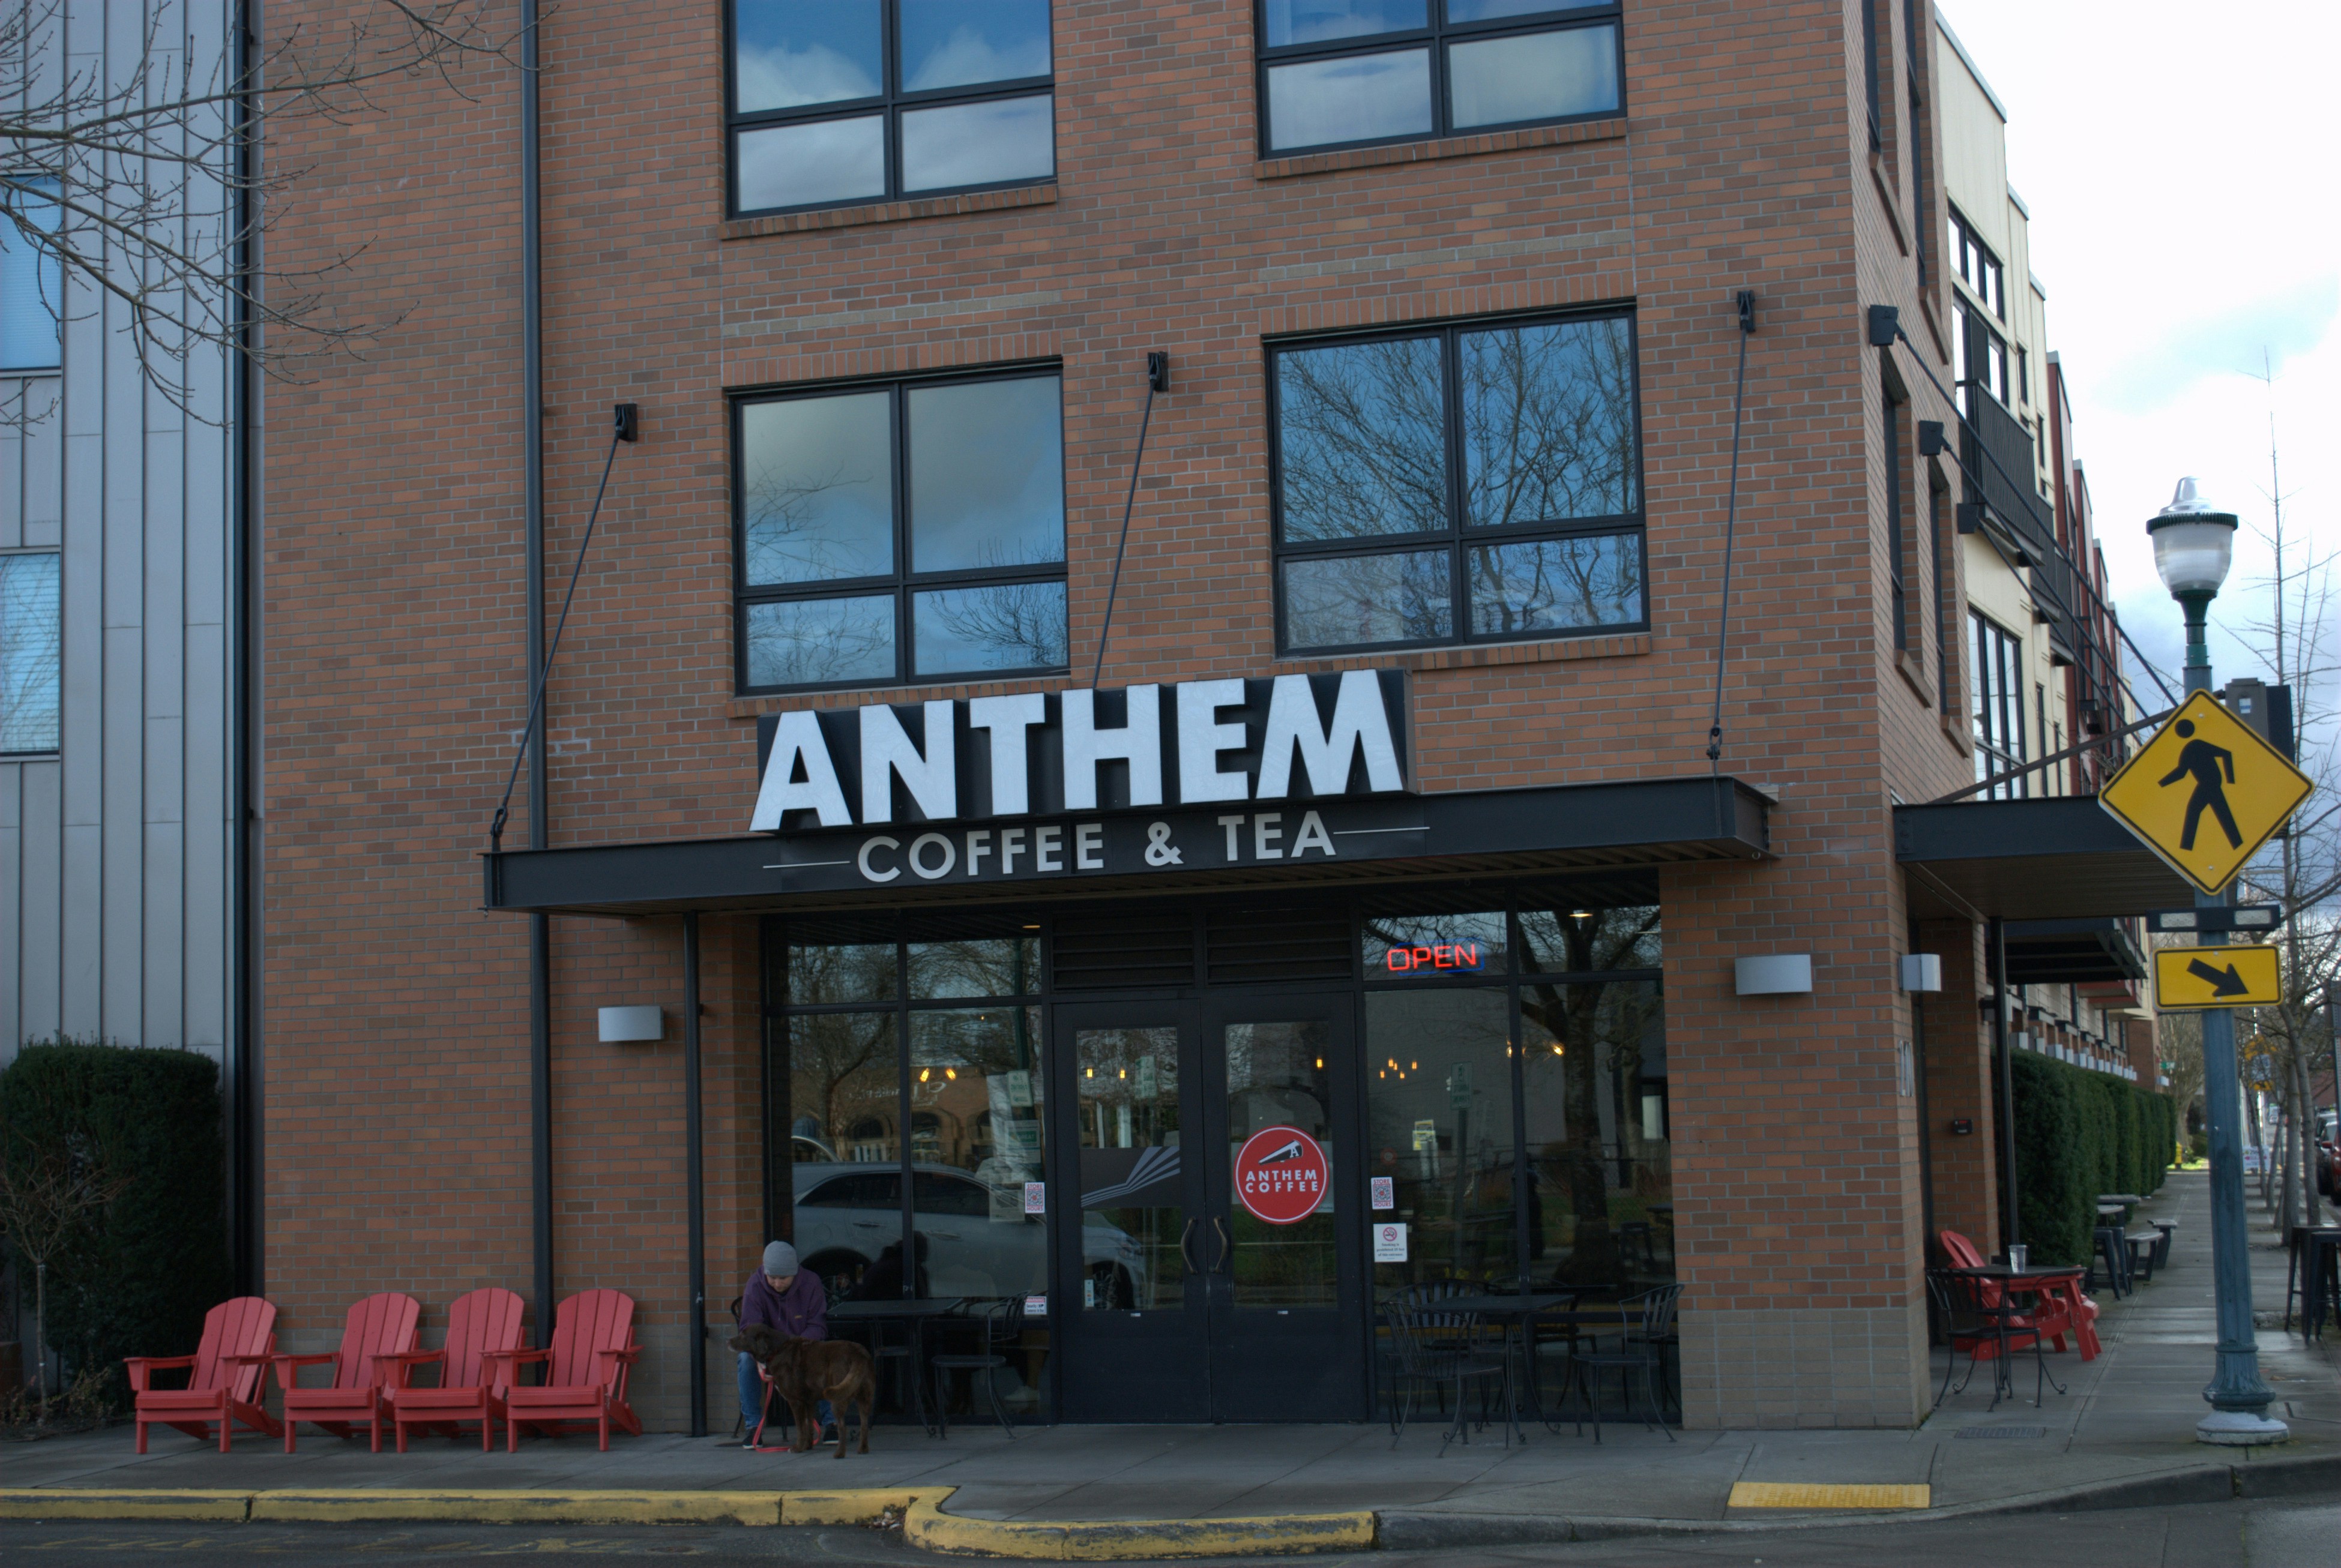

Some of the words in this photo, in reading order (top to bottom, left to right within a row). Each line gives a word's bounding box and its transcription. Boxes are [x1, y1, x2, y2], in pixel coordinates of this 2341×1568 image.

[749, 668, 1405, 832] ANTHEM
[857, 822, 1104, 883] COFFEE
[1144, 821, 1184, 867] &
[1217, 810, 1337, 862] TEA
[1387, 943, 1477, 971] OPEN
[1289, 1147, 1300, 1158] A
[1246, 1170, 1317, 1182] ANTHEM
[1245, 1181, 1318, 1193] COFFEE
